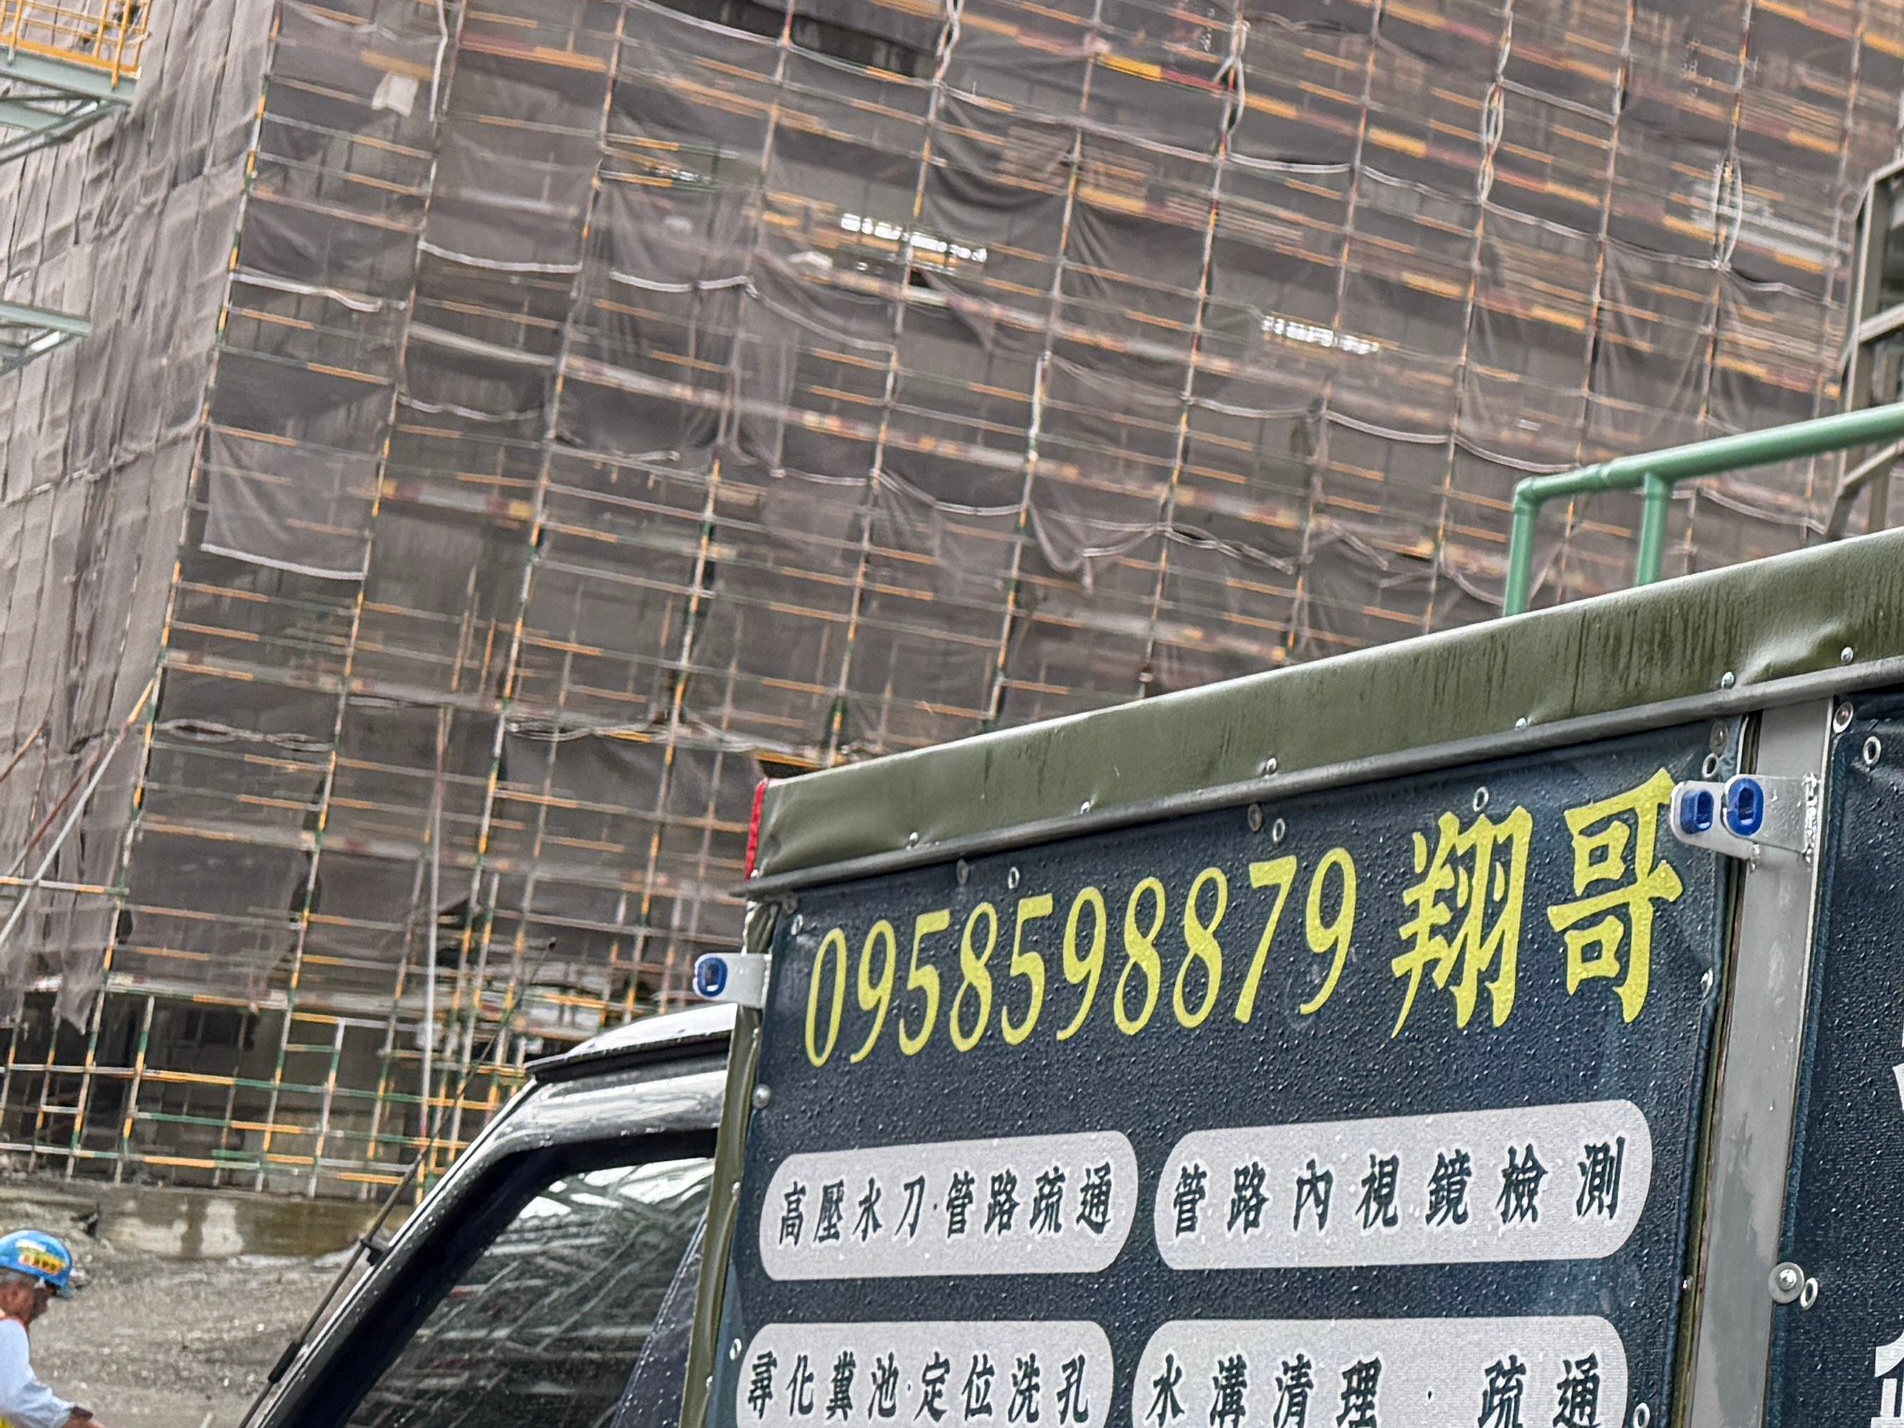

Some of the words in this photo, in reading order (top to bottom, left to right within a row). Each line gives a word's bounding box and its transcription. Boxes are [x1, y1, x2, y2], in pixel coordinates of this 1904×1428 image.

[804, 846, 1358, 1070] 0958598879
[1391, 766, 1686, 1040] 翔哥
[1172, 1135, 1627, 1238] 管路內視鏡檢測
